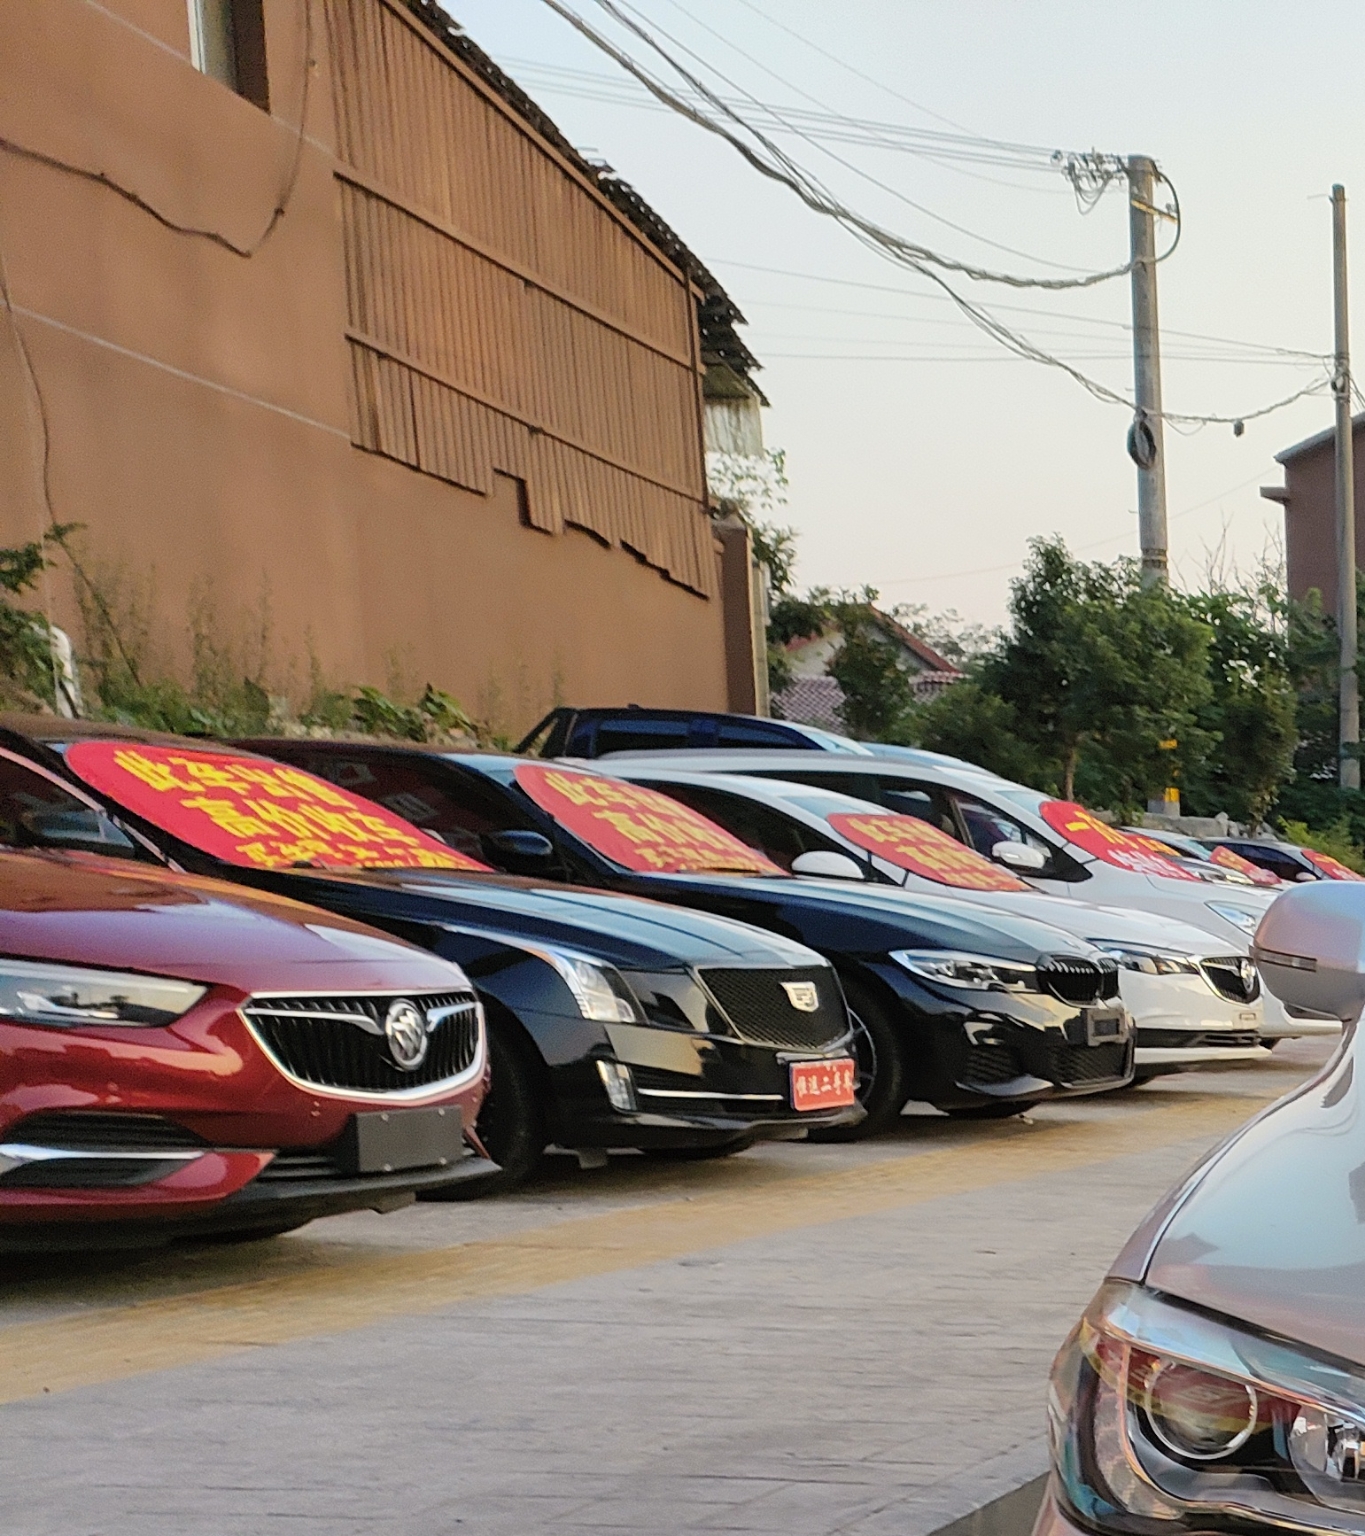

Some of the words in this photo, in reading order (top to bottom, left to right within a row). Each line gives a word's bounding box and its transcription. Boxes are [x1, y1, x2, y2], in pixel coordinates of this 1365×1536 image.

[113, 750, 357, 809] 此车出售
[181, 796, 420, 847] 高价收车
